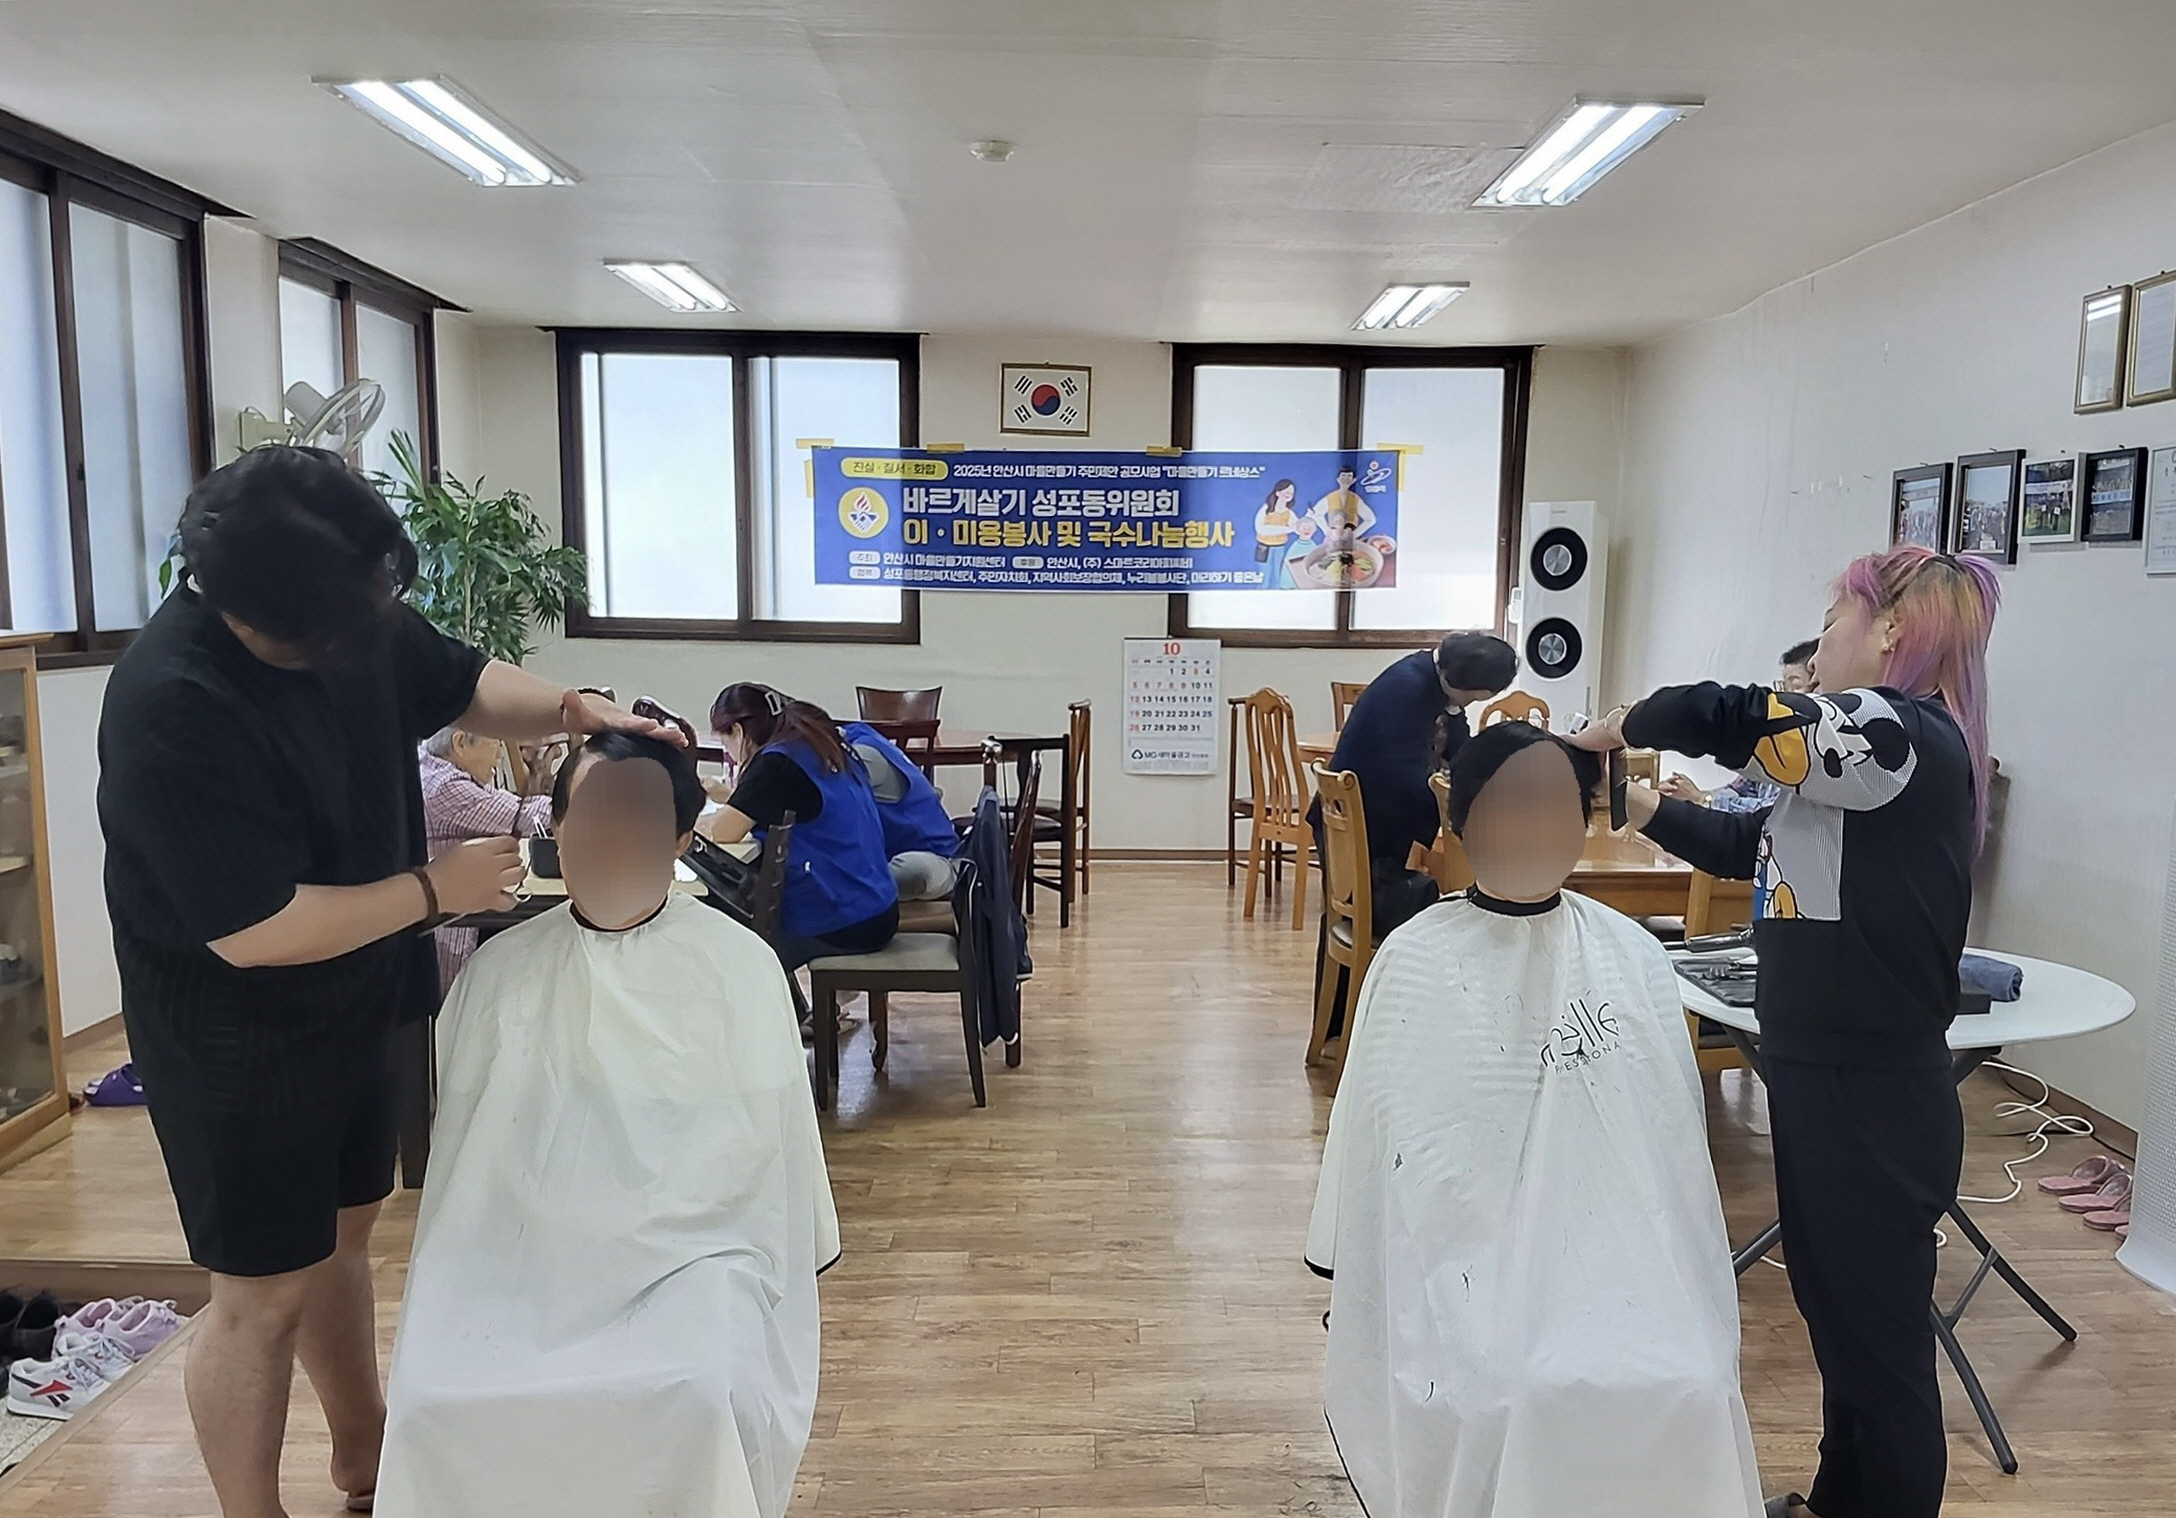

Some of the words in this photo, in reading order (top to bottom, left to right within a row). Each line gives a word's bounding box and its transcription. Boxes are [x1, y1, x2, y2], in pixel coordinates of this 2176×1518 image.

[853, 462, 874, 474] 진실
[884, 462, 905, 474] 질서
[913, 462, 937, 475] 화합
[953, 465, 992, 477] 2025년
[993, 465, 1024, 477] 안산시
[903, 487, 1026, 516] 바르게살기
[1031, 488, 1180, 517] 성포동위원회
[952, 520, 1051, 547] 미용봉사
[1057, 520, 1082, 547] 및
[1088, 520, 1235, 548] 국수나눔행사
[883, 553, 914, 565] 안산시
[1083, 557, 1101, 569] (주)
[1163, 642, 1181, 655] 10
